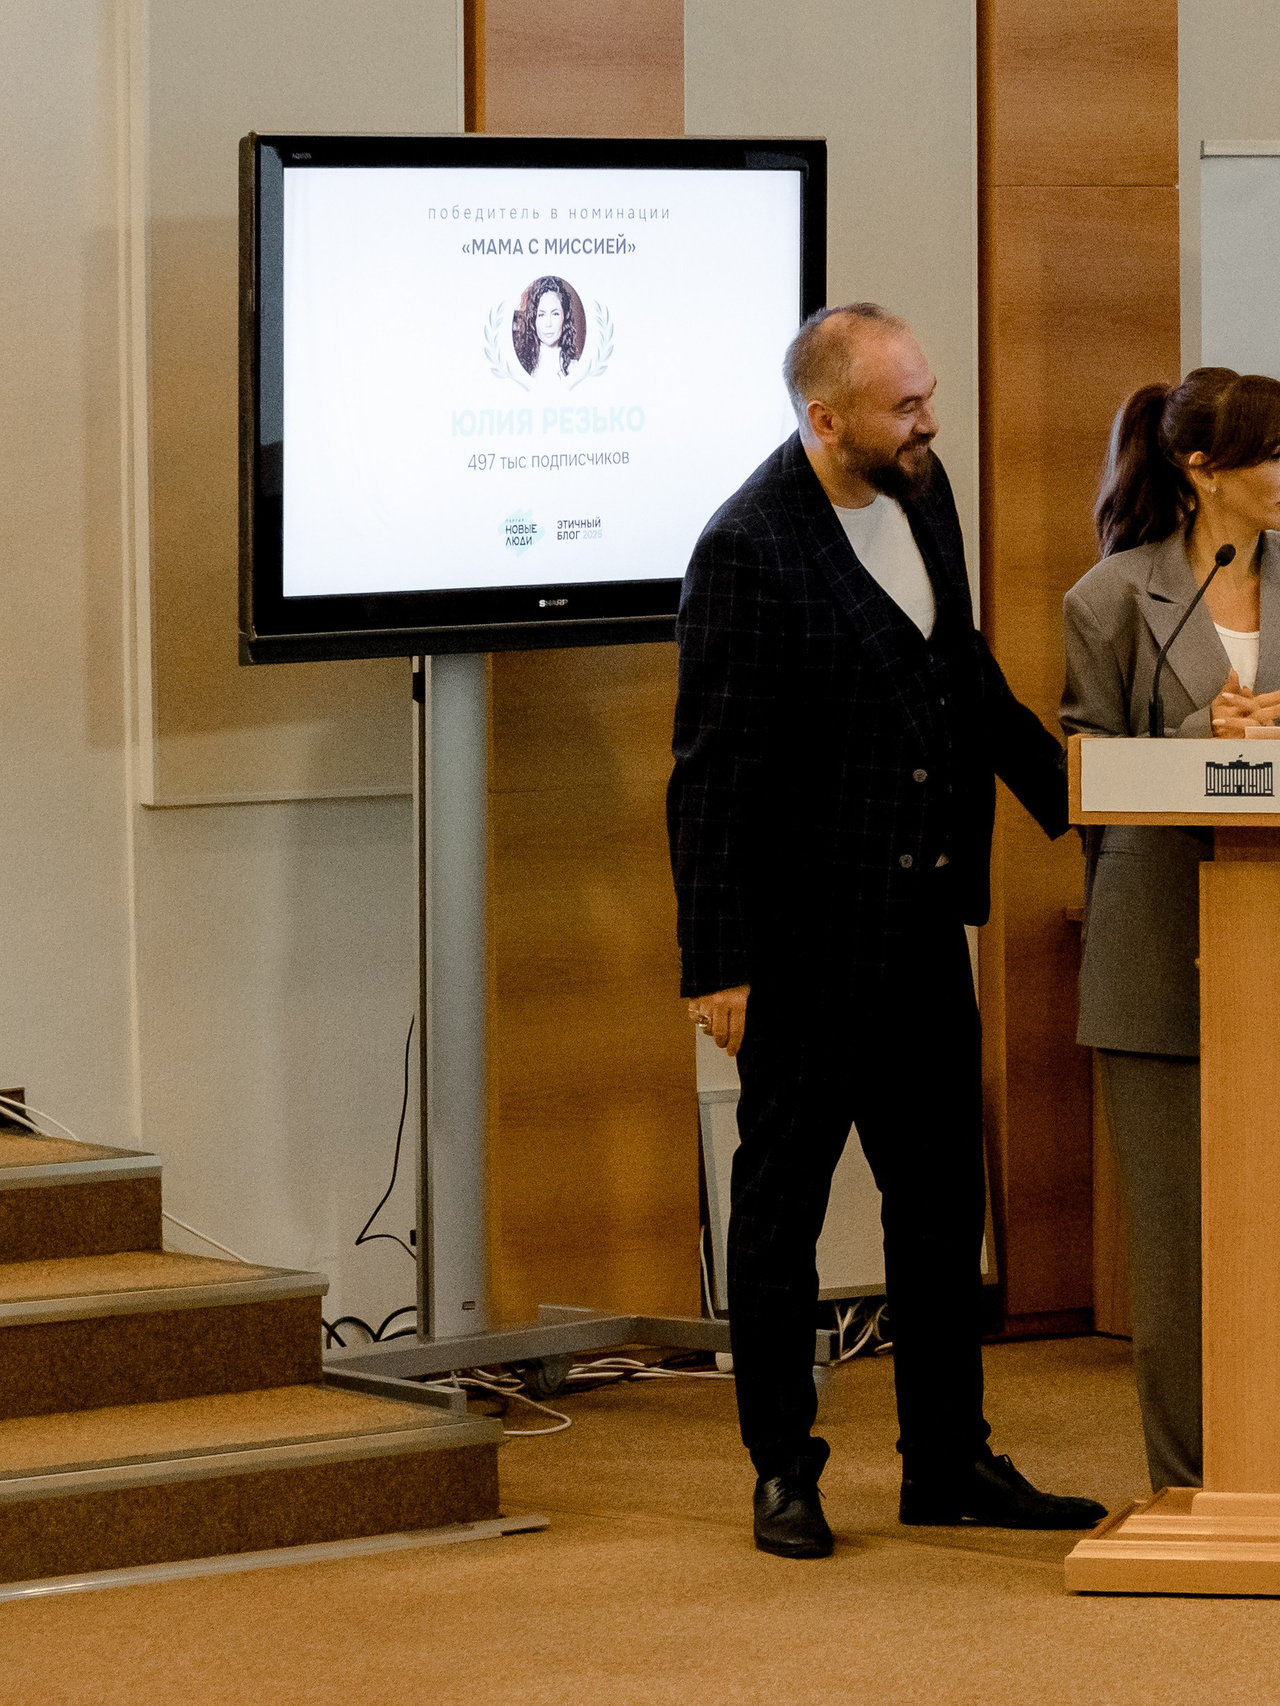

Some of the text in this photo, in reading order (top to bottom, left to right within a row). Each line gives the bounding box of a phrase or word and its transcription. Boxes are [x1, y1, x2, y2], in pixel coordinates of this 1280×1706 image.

[428, 205, 670, 223] победитель в номинации
[461, 233, 636, 255] «МАМА С МИССИЕЙ»
[450, 405, 646, 437] ЮЛИЯ РЕЗЬКО
[467, 453, 496, 471] 497
[505, 523, 538, 535] НОВЫЕ
[556, 516, 602, 530] ЭТИЧНЫЙ
[505, 535, 533, 547] ЛЮДИ
[557, 529, 603, 541] БЛОГ 2025
[538, 598, 569, 608] SHARP
